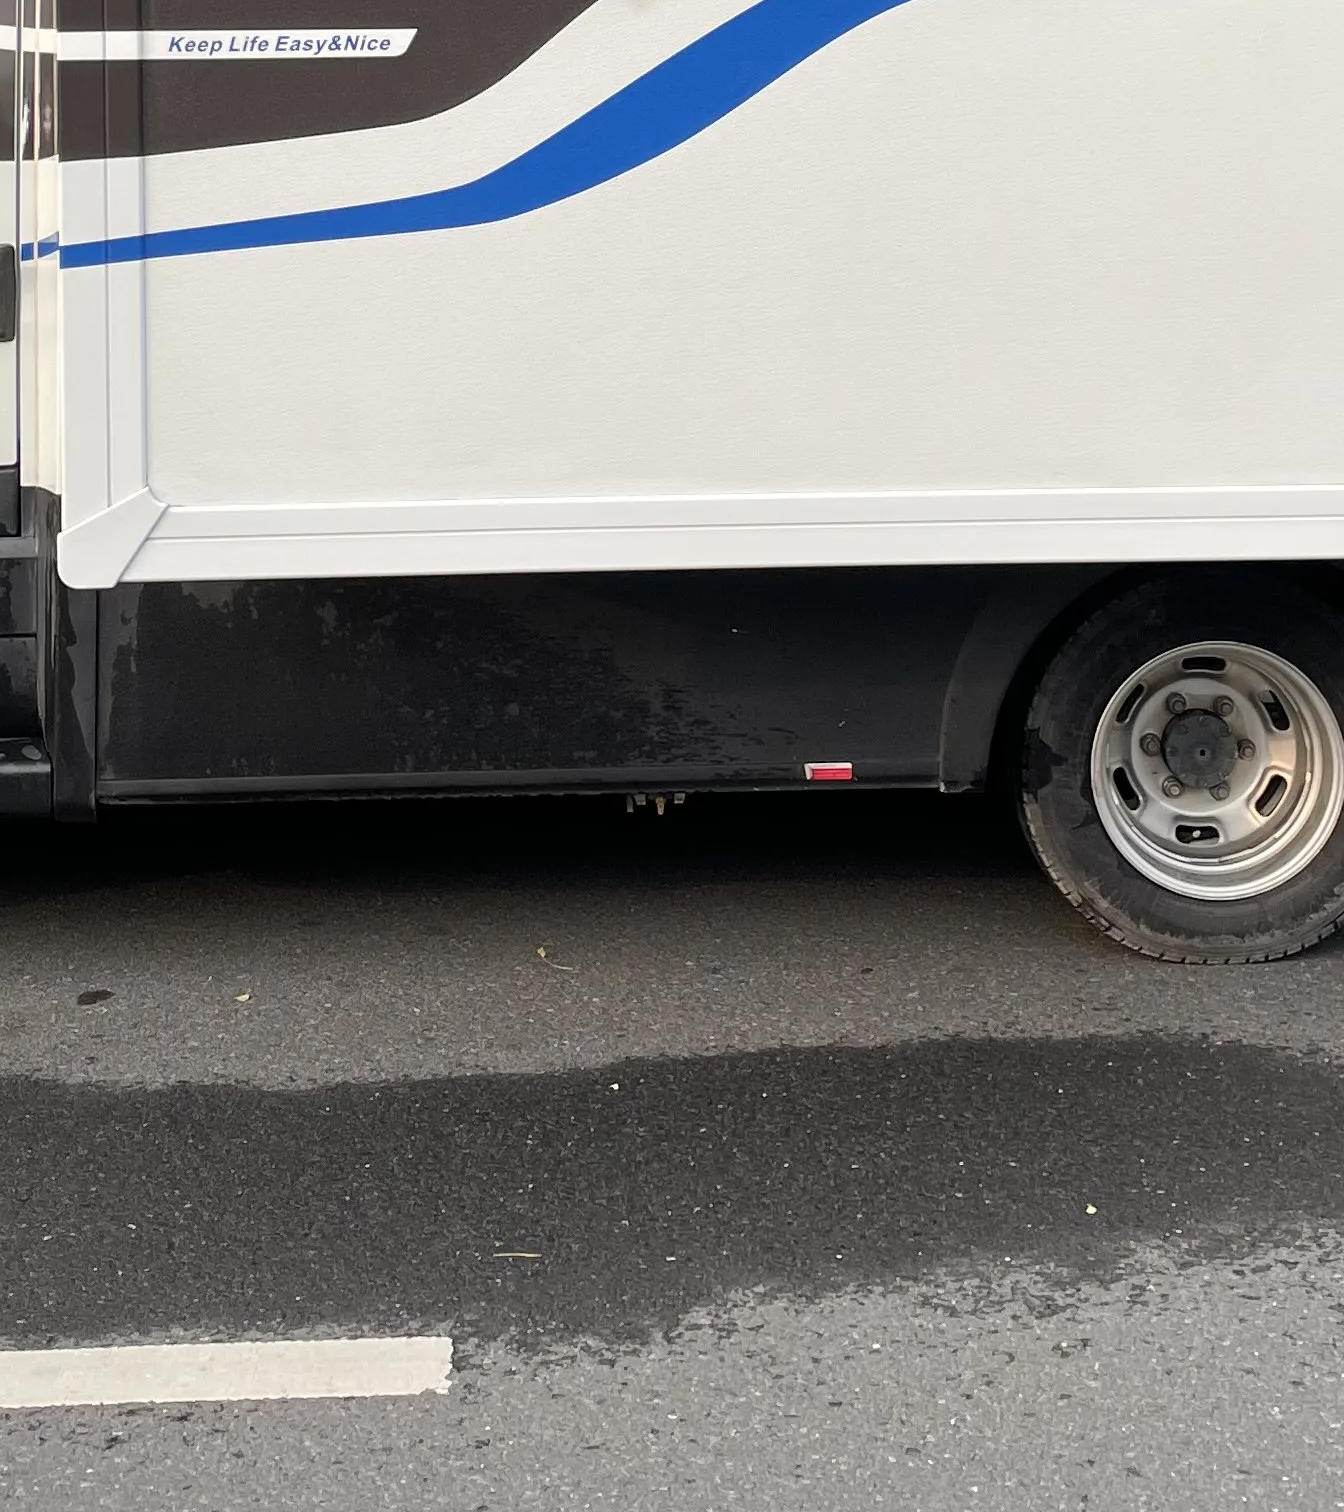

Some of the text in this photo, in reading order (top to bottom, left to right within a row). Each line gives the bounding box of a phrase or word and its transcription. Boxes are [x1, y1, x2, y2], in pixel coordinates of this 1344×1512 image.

[168, 35, 391, 55] Keep Life Easy&Nice
